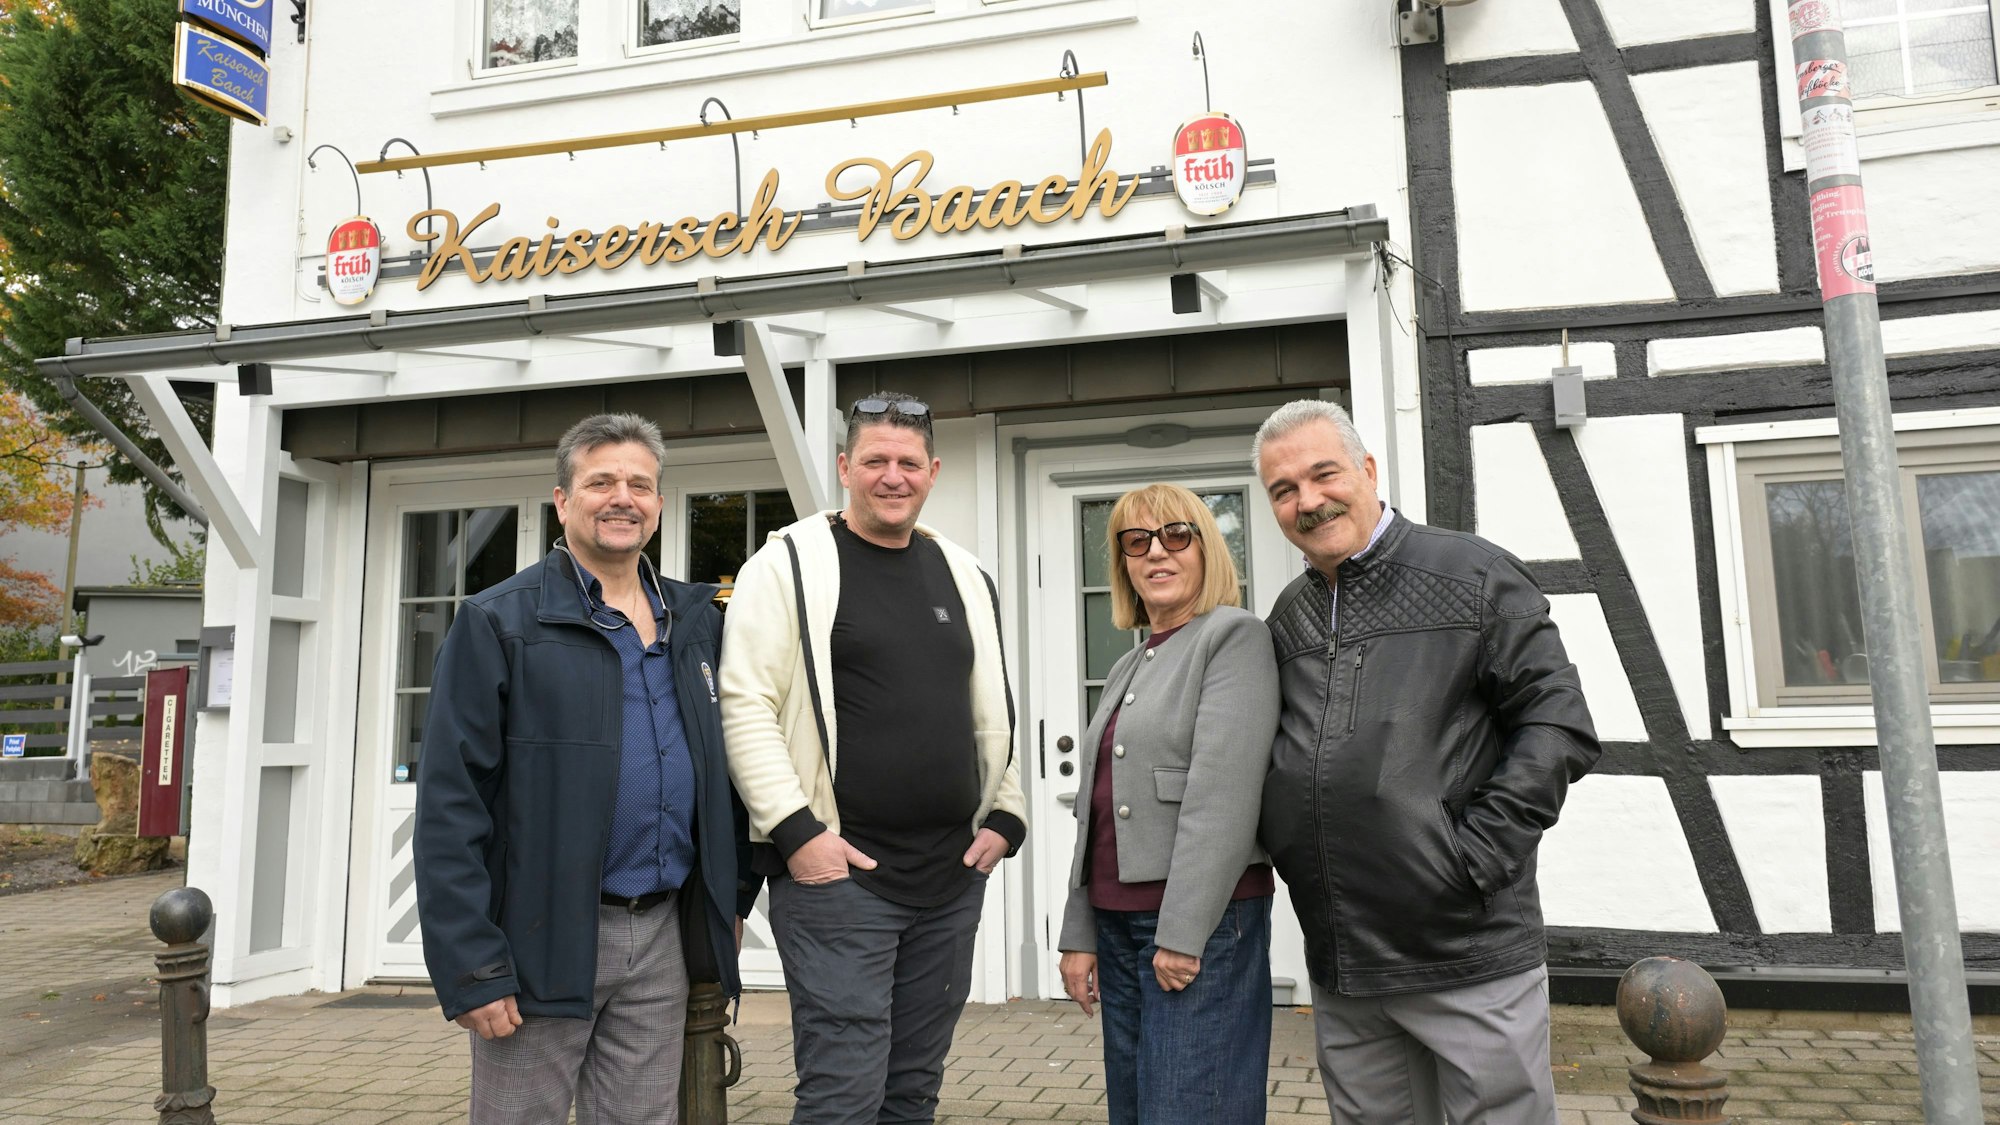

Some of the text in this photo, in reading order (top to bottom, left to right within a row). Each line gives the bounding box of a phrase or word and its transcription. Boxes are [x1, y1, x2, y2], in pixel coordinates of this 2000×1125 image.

[197, 39, 265, 87] Kaisersch
[211, 68, 256, 104] Baach
[1184, 154, 1234, 182] früh
[1195, 182, 1226, 191] KÖLSCH
[406, 126, 1139, 291] Kaisersch Baach
[334, 252, 371, 277] früh
[162, 699, 174, 781] CIGARETTEN
